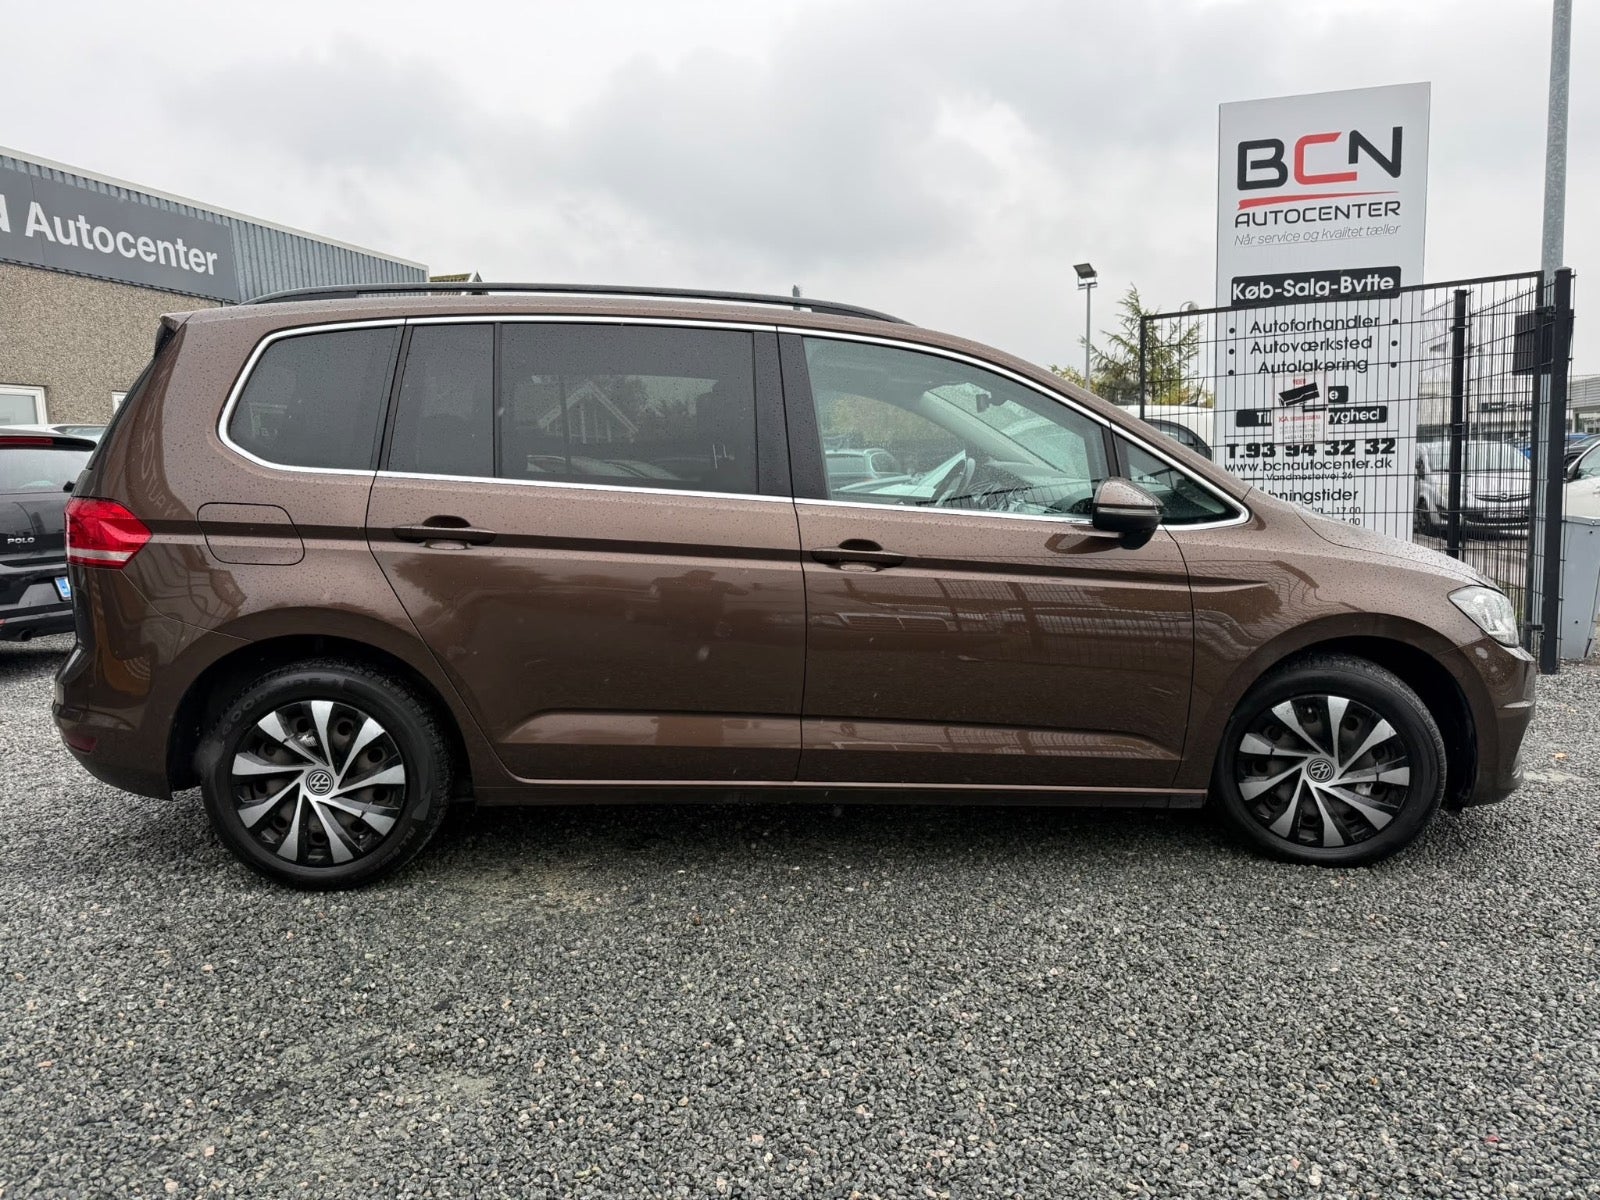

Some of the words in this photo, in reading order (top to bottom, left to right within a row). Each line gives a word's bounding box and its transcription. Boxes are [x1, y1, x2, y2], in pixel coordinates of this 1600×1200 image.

[1237, 126, 1403, 190] BCN
[1235, 200, 1401, 228] AUTOCENTER
[25, 200, 218, 276] Autocenter
[1235, 233, 1254, 246] Når
[1258, 229, 1301, 245] service
[1303, 231, 1319, 243] og
[1322, 224, 1363, 240] kvalitet
[1366, 222, 1401, 236] tæller
[1250, 316, 1380, 334] Autoforhandler
[1250, 336, 1373, 354] Autoværksted
[1258, 357, 1369, 374] Autolakering
[1256, 411, 1271, 424] Til
[1328, 408, 1380, 424] ryghed
[1226, 442, 1276, 459] T.93
[1285, 443, 1316, 457] 94
[1325, 440, 1356, 456] 32
[1365, 438, 1396, 454] 32
[1225, 457, 1393, 473] www.bcnautocenter.dk
